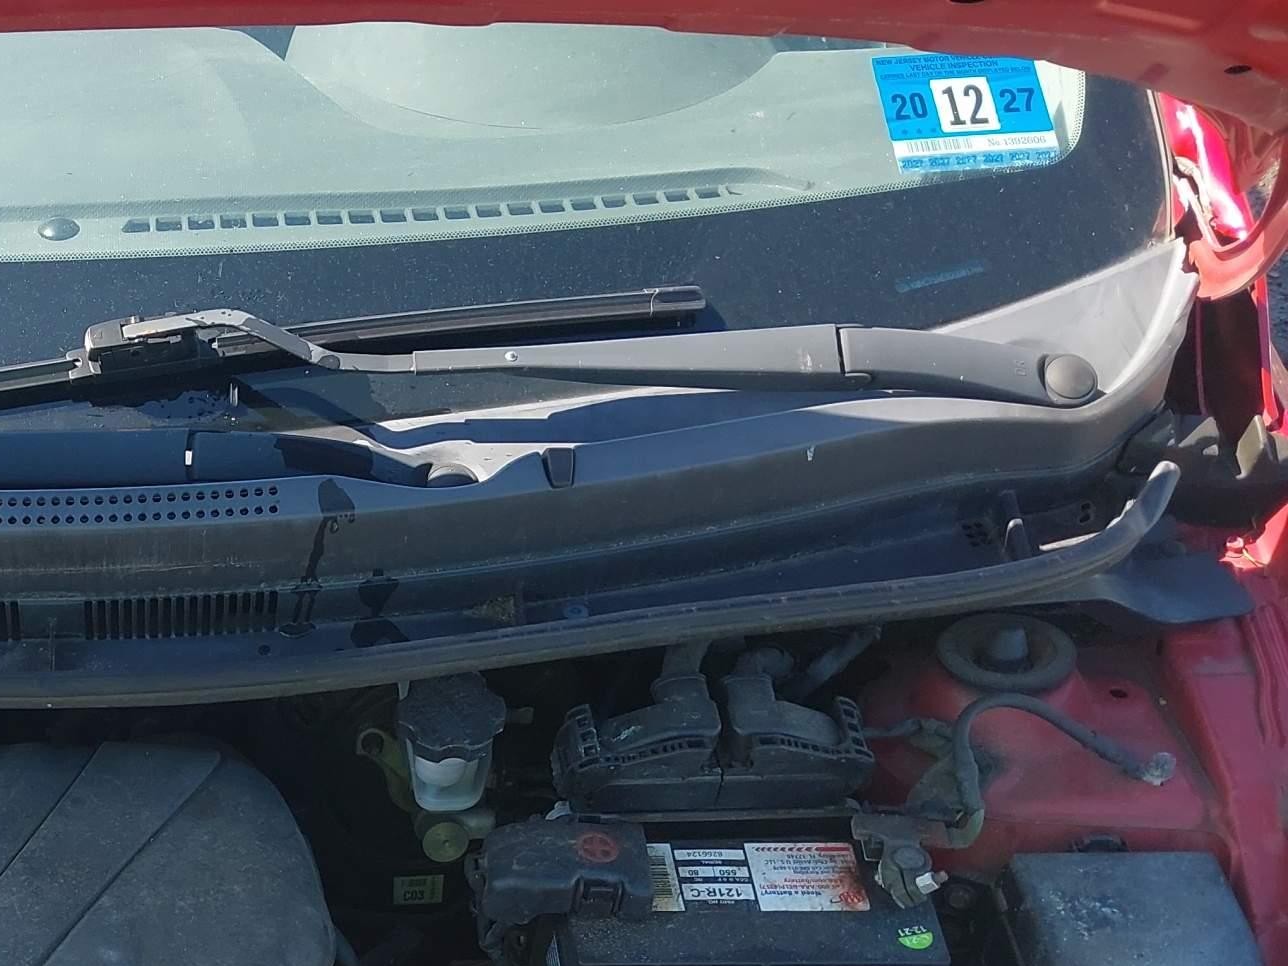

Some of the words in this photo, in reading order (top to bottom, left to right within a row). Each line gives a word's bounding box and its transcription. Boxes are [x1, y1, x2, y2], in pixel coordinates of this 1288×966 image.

[894, 57, 922, 65] JERSEY
[910, 62, 945, 72] VEHICLE
[947, 60, 998, 70] INSPECTION
[891, 92, 928, 120] 20
[942, 84, 990, 126] 12
[999, 87, 1035, 113] 27
[690, 887, 742, 898] 121R-C
[760, 889, 792, 897] Battery?
[897, 924, 927, 937] 12-21
